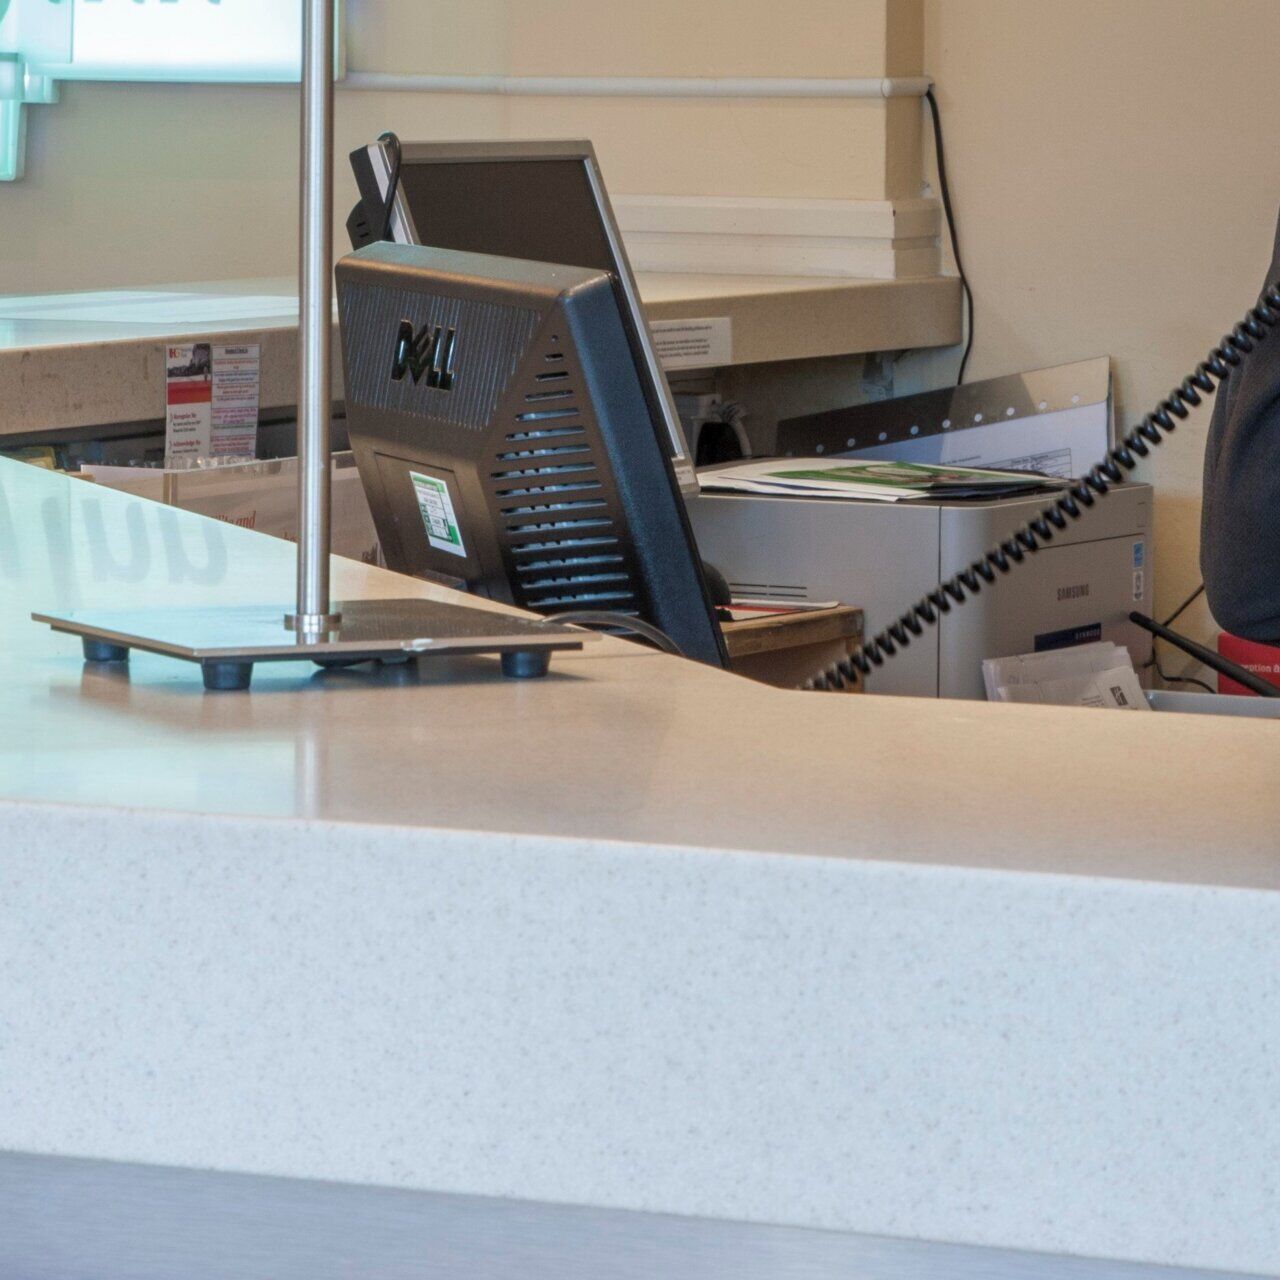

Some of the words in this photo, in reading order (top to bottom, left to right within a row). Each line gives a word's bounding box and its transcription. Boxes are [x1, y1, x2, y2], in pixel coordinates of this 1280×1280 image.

[391, 319, 455, 391] DELL
[1057, 583, 1090, 601] SAMSUNG
[1273, 663, 1280, 673] &
